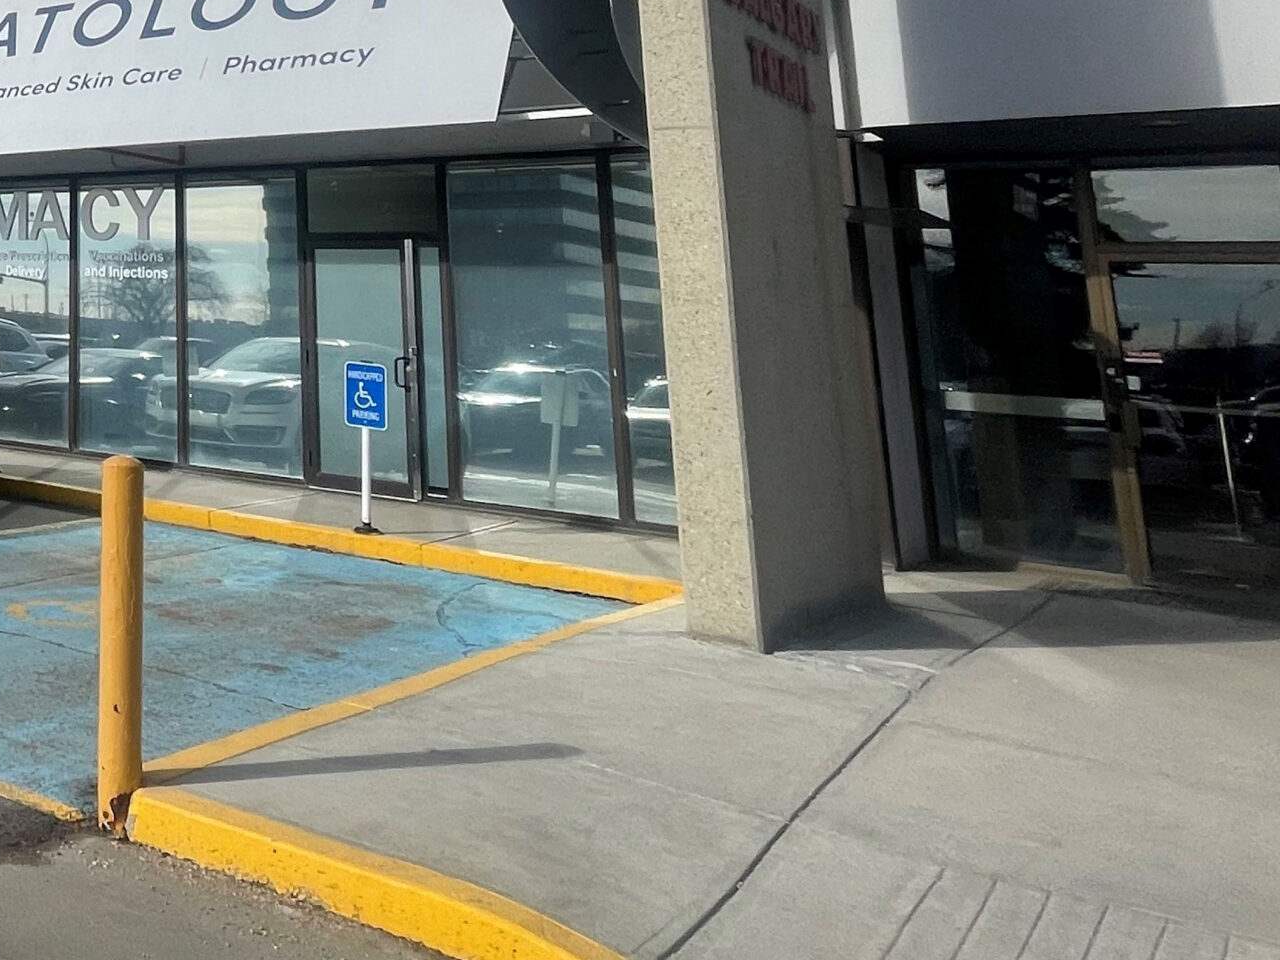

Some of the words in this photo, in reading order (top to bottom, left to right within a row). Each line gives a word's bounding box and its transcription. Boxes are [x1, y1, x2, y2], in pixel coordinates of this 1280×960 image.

[66, 71, 114, 92] Skin
[122, 68, 183, 86] Care
[223, 47, 376, 76] Pharmacy
[84, 266, 107, 277] and
[108, 266, 169, 281] Injections
